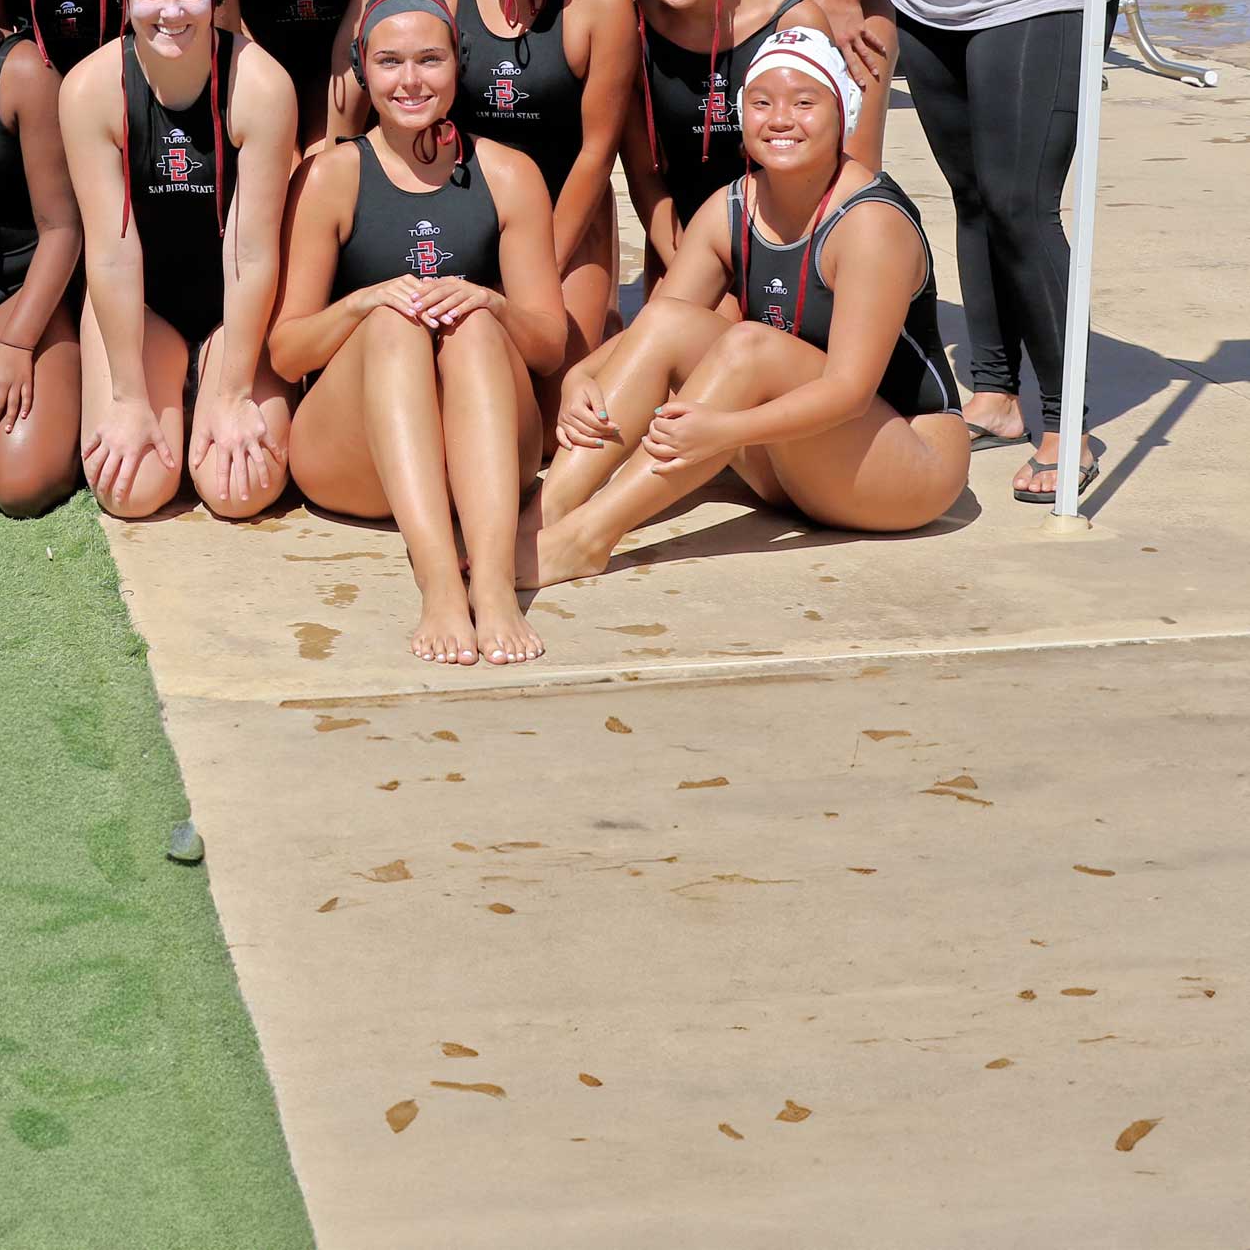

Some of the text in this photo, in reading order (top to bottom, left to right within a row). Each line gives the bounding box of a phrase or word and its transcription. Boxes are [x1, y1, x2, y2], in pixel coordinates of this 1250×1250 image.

[491, 68, 522, 76] TURBO
[476, 110, 541, 120] SAN DIEGO STATE
[709, 124, 732, 133] DIEGO
[161, 136, 192, 144] TURBO
[148, 183, 215, 194] SAN DIEGO STATE
[408, 227, 441, 237] TURBO
[764, 286, 788, 295] TURBO
